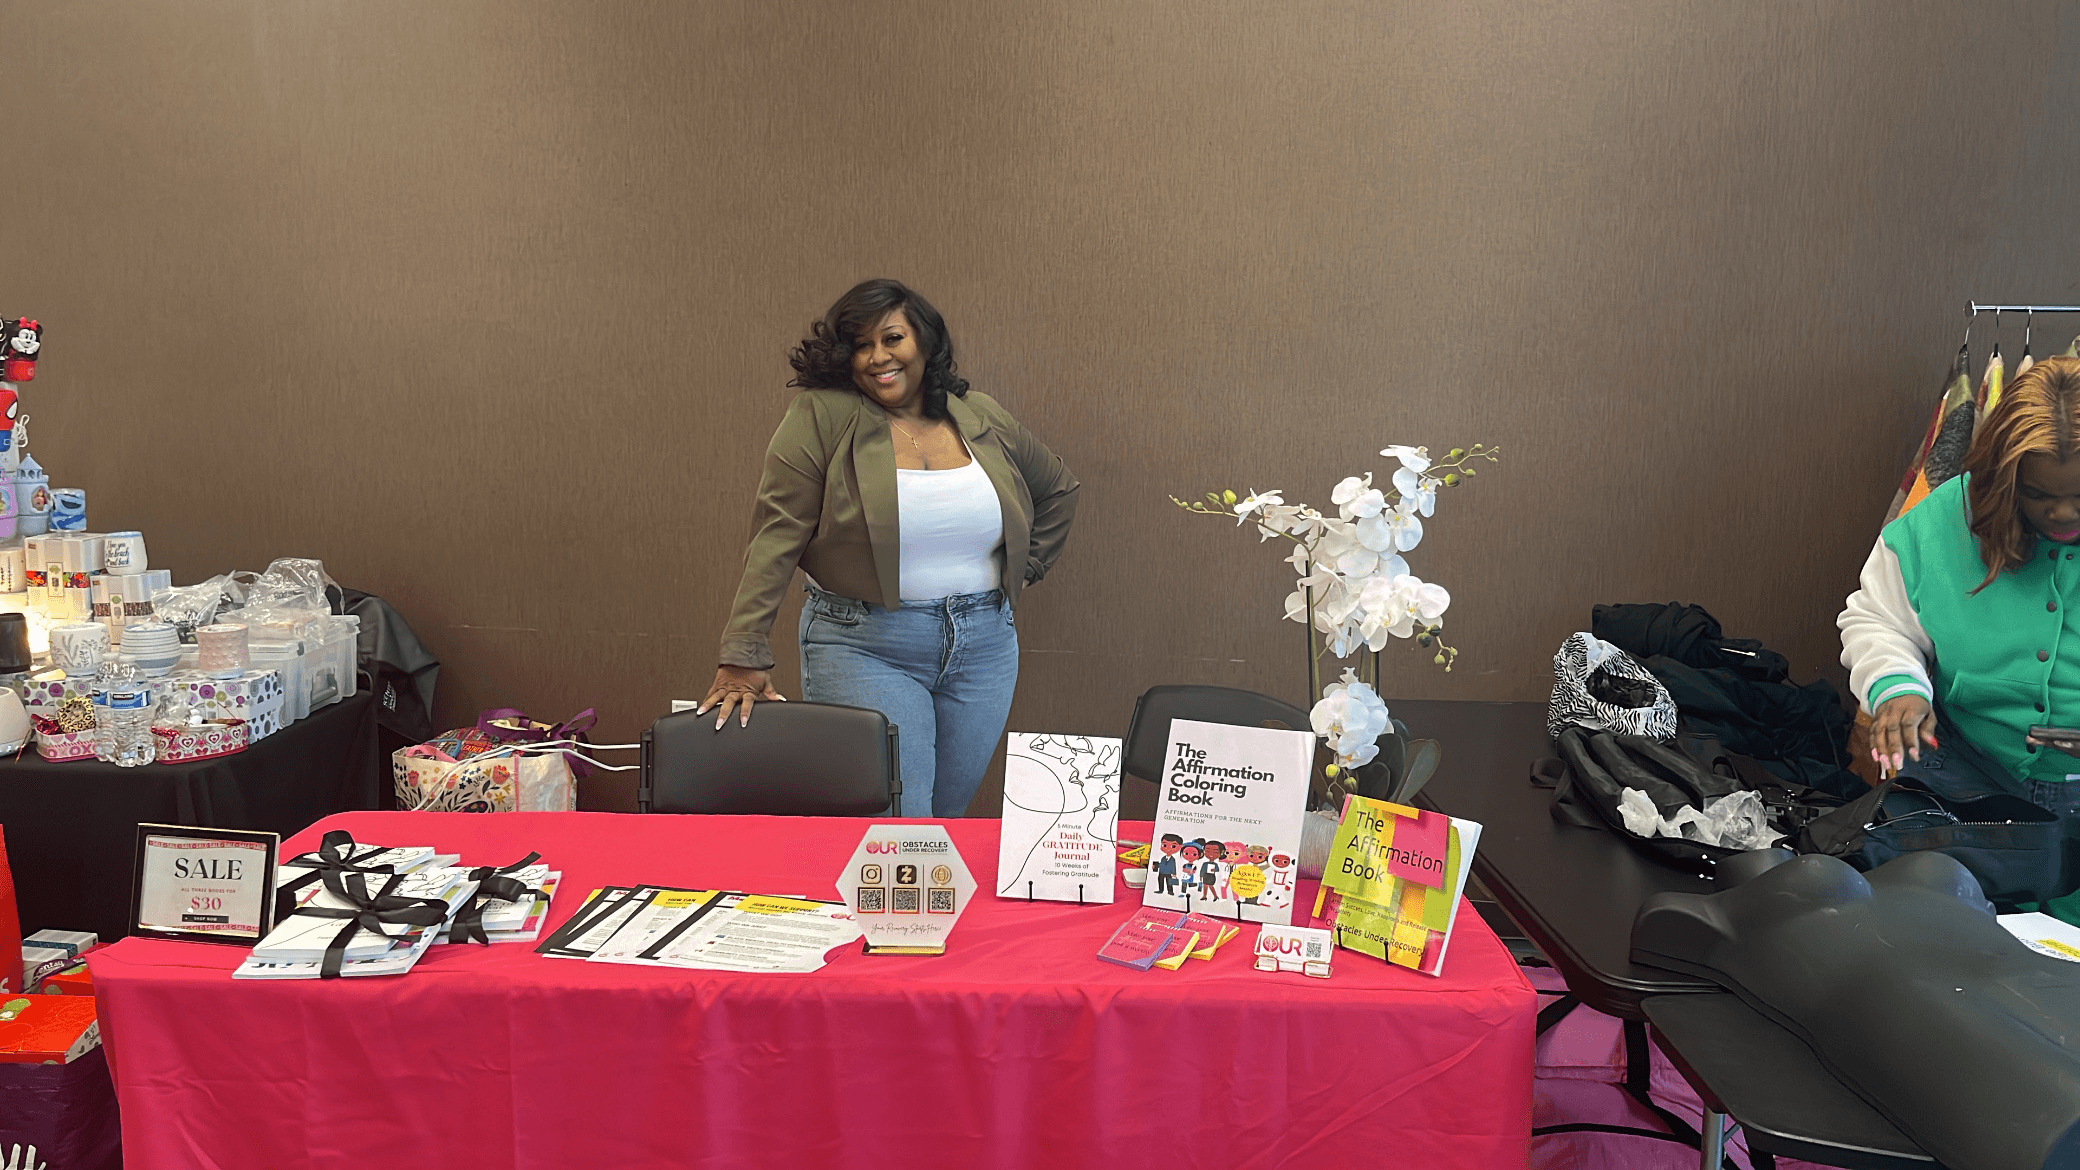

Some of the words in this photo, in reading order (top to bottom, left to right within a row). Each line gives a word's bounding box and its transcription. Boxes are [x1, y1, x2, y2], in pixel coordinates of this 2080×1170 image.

[1176, 742, 1207, 759] The
[1172, 758, 1275, 782] Affirmation
[1170, 773, 1247, 798] Coloring
[1168, 787, 1214, 806] Book
[1163, 815, 1206, 824] GENERATION
[1165, 809, 1213, 819] AFFIRMATIONS
[1356, 811, 1384, 833] The
[1060, 832, 1084, 841] Daily
[866, 841, 897, 854] OUR
[1042, 841, 1103, 851] GRATITUDE
[1347, 834, 1443, 873] Affirmation
[1054, 851, 1090, 861] Journal
[174, 857, 243, 880] SALE
[1070, 870, 1100, 878] Gratitude
[1341, 857, 1385, 883] Book
[191, 896, 222, 910] $30
[871, 923, 884, 934] Your
[1262, 935, 1302, 956] OUR
[1326, 918, 1362, 937] Obstacles
[1389, 938, 1425, 957] Recovery
